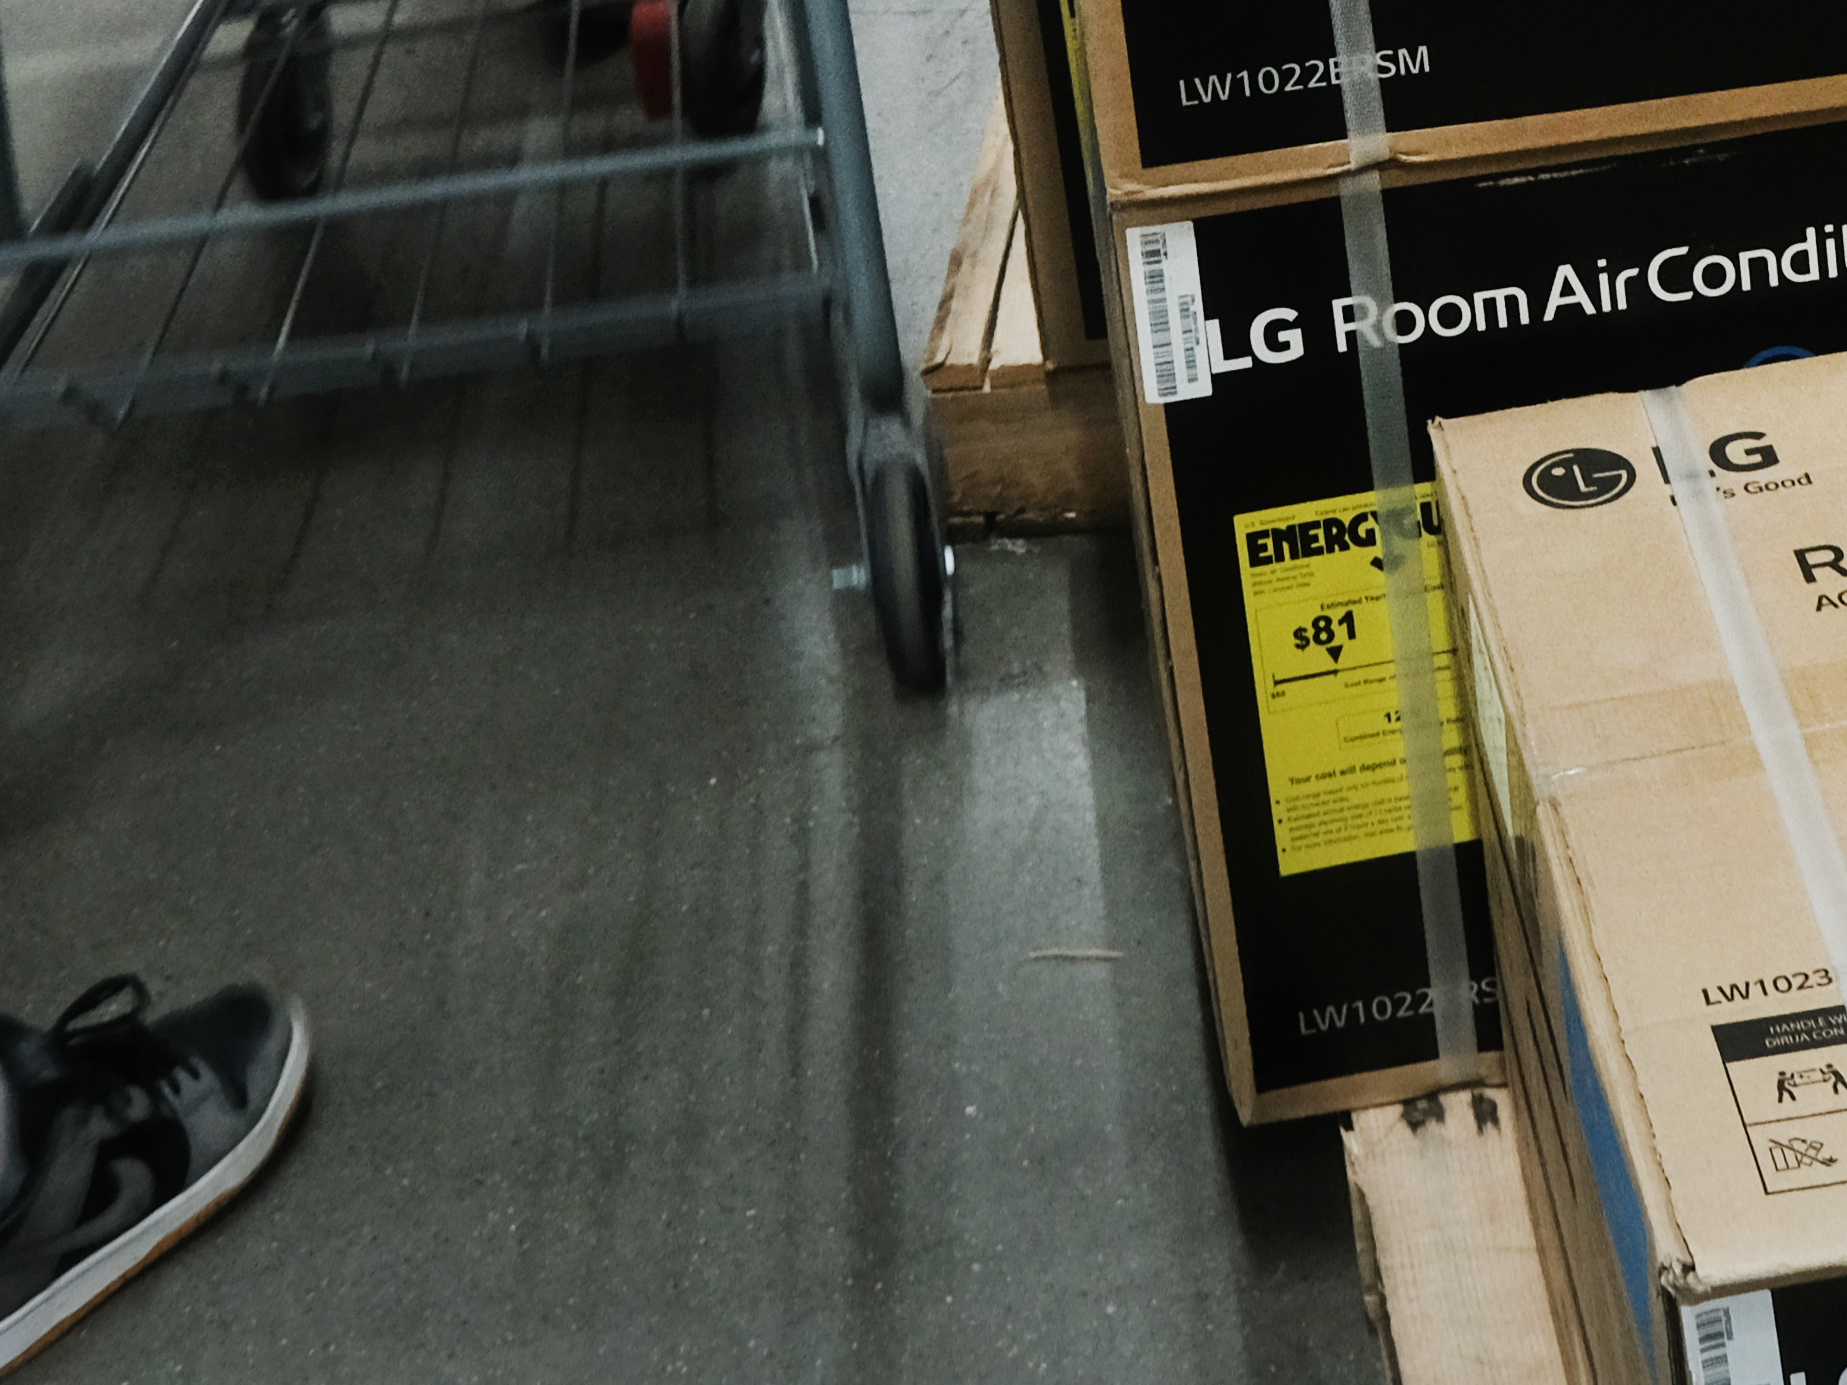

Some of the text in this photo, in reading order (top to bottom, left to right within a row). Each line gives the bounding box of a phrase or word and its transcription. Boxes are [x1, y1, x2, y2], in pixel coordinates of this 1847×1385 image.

[1179, 45, 1431, 106] LW1022ESM
[1206, 306, 1304, 375] LG
[1331, 284, 1530, 354] Room
[1743, 472, 1813, 496] Good
[1293, 610, 1357, 653] $81
[1769, 1014, 1827, 1035] HANDLE
